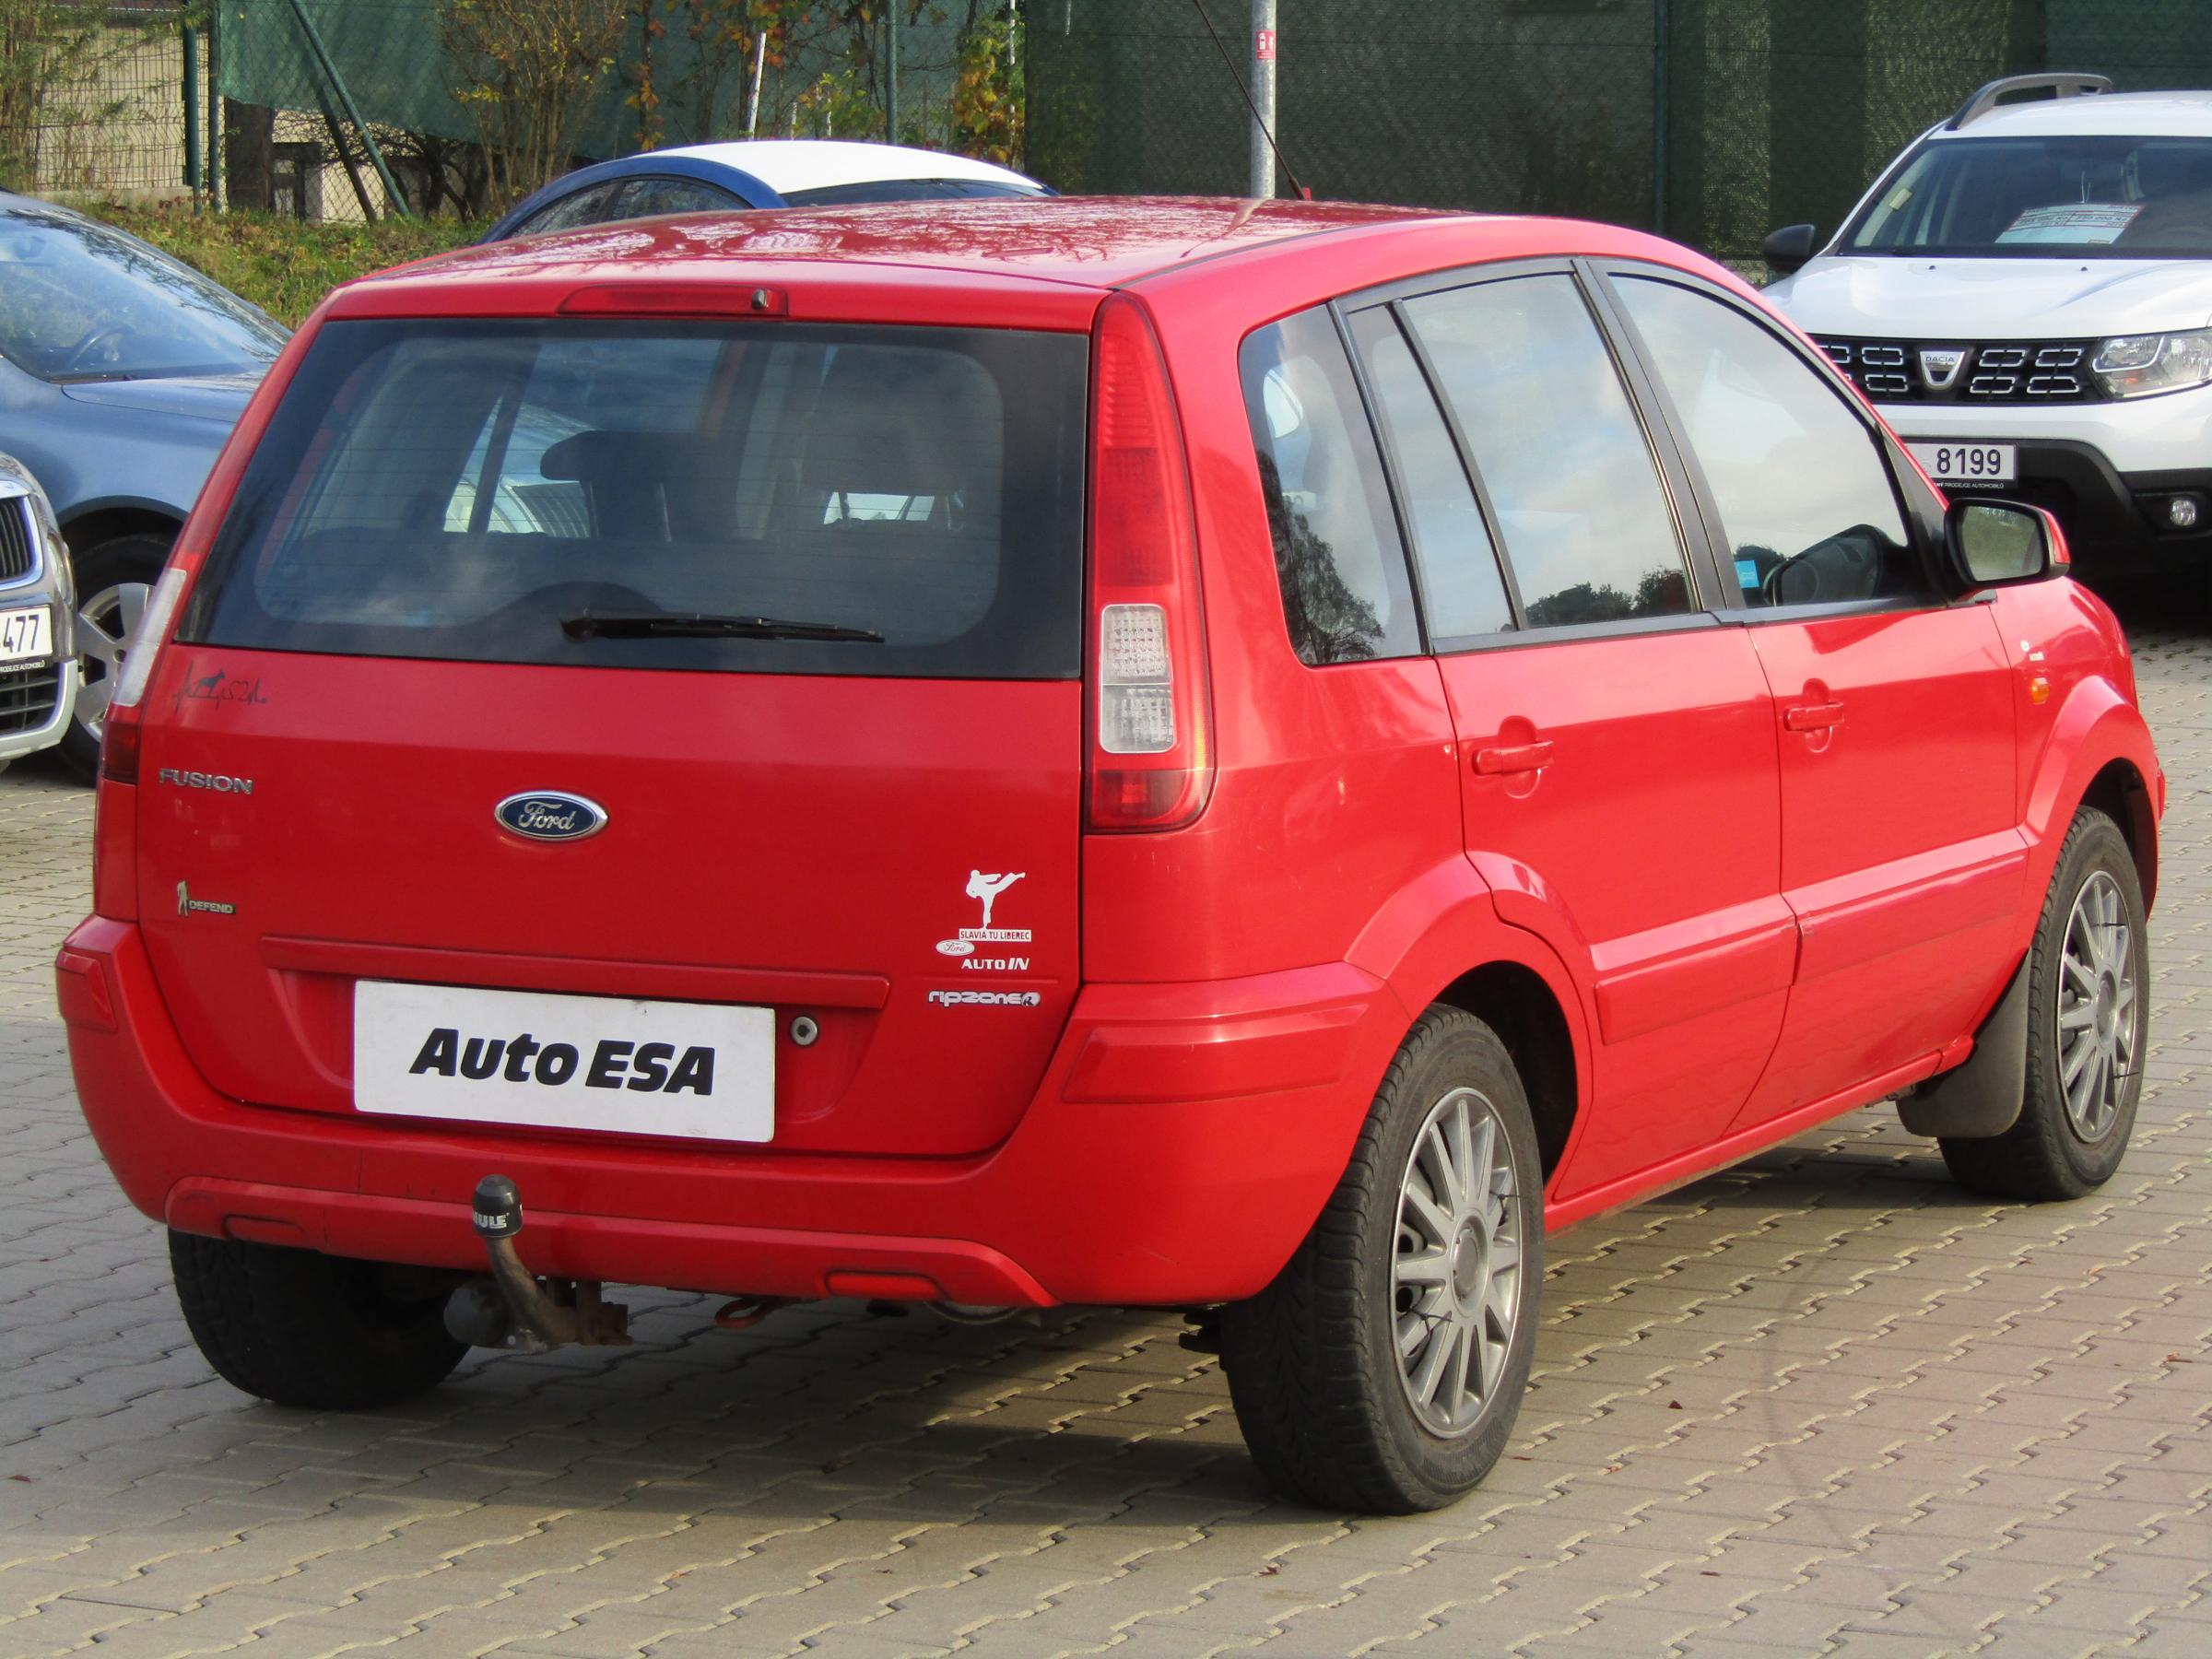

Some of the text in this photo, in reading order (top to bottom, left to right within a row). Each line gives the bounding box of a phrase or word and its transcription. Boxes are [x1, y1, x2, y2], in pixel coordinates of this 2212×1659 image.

[1936, 448, 2001, 475] 8199
[0, 614, 40, 653] 477
[159, 768, 253, 795] FUSION
[518, 801, 577, 830] Ford
[189, 900, 233, 914] DEFEND
[960, 930, 1030, 940] SLAVIA TU LIBEREC
[961, 958, 1030, 971] AUTO IN
[408, 1027, 716, 1097] Auto ESA
[472, 1209, 507, 1229] HULE
